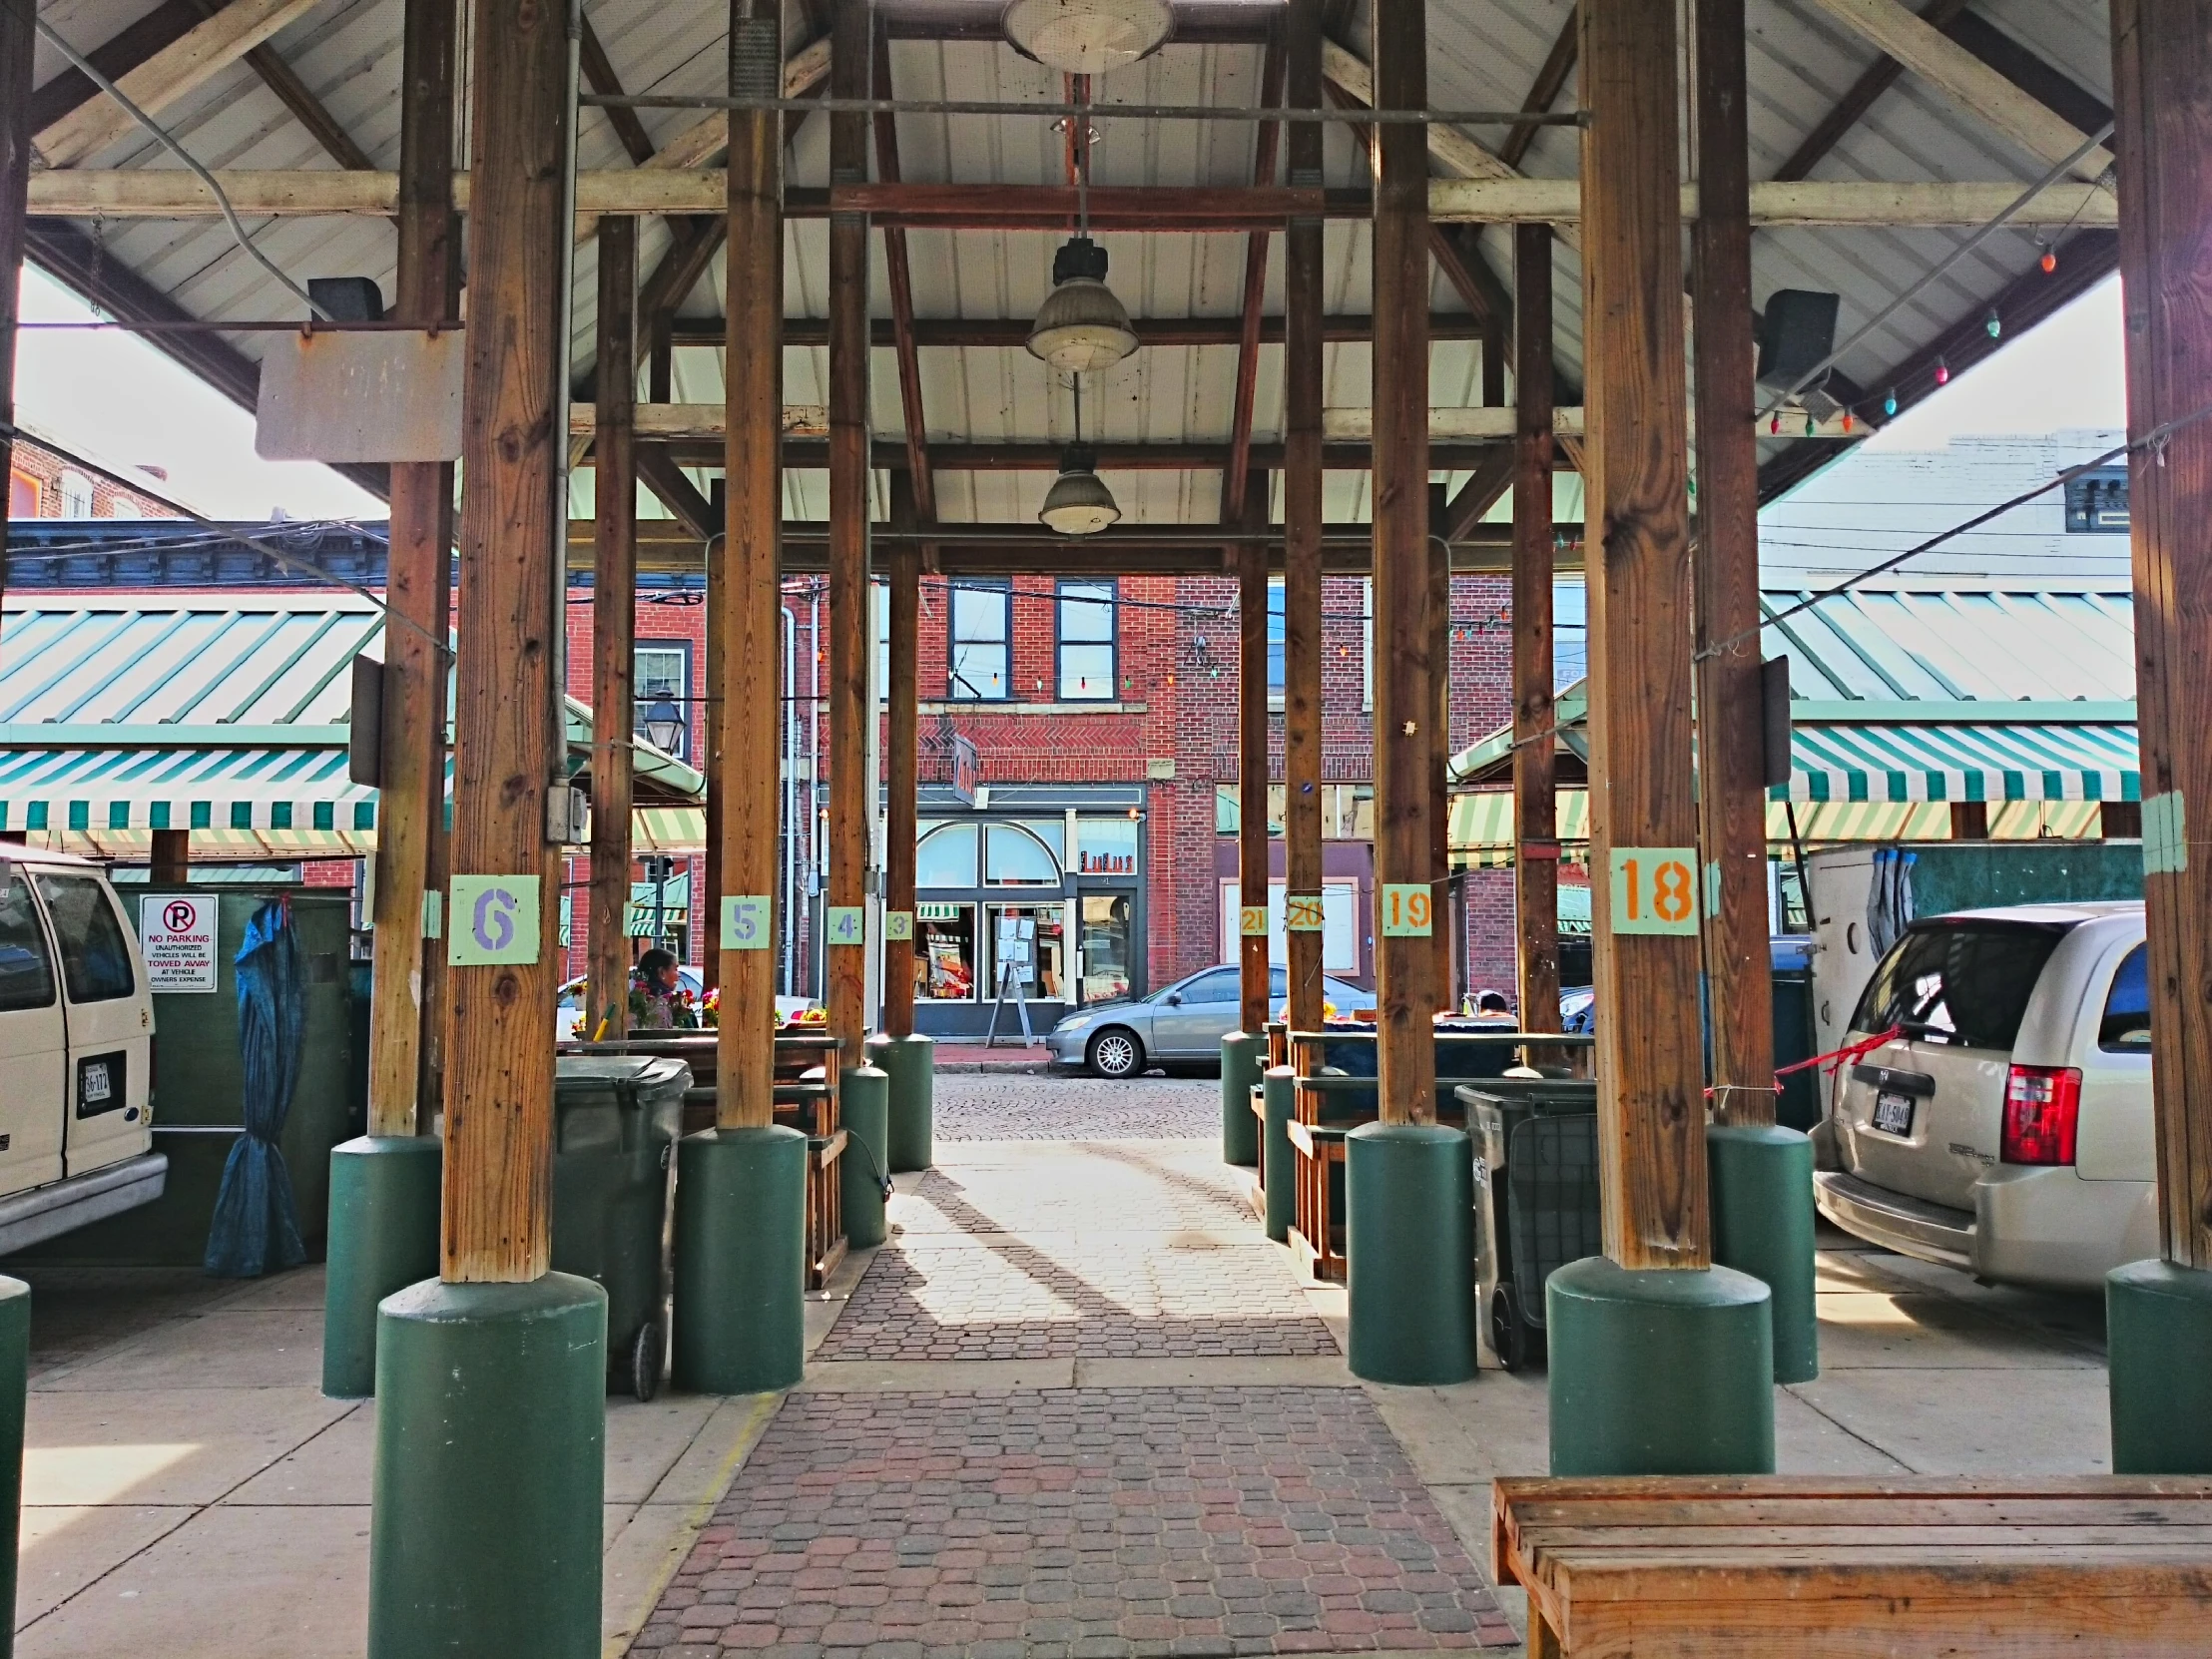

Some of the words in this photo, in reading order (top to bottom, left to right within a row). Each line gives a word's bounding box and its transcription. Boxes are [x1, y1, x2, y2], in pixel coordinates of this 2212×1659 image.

[1621, 859, 1693, 922] 18
[473, 888, 516, 951] 6
[734, 903, 757, 940] 5
[1242, 909, 1264, 930] 21
[1289, 900, 1323, 926] 20
[1389, 890, 1430, 928] 19
[837, 913, 853, 939] 4
[892, 915, 906, 935] 3
[148, 934, 164, 943] NO
[167, 934, 210, 943] PARKING
